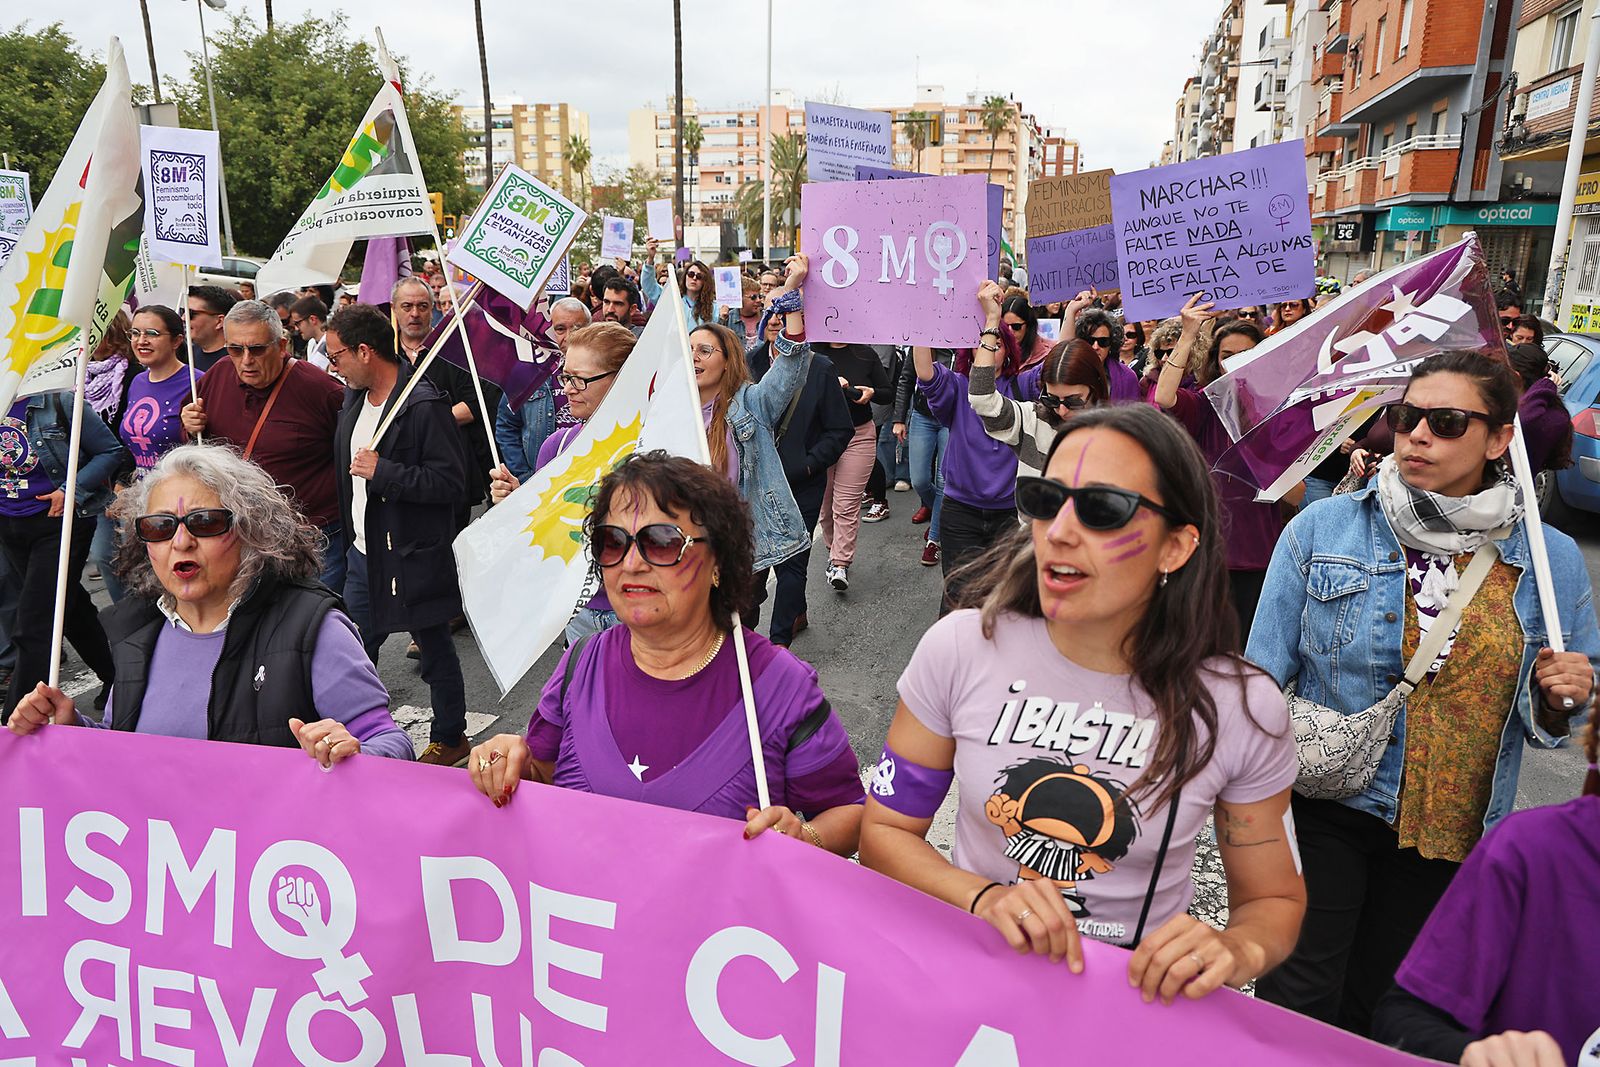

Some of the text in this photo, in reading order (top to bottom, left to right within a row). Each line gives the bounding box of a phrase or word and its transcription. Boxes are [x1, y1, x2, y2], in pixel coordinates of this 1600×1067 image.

[811, 115, 820, 124] LA
[820, 116, 850, 130] MAESTRA
[161, 166, 187, 184] 8M
[1033, 173, 1111, 201] FEMINISMO
[157, 193, 203, 203] para cambiarlo
[1140, 167, 1269, 211] MARCHAR!!!
[187, 202, 203, 210] todo
[507, 194, 551, 225] 8M
[1123, 200, 1250, 236] AUNQUE NO TE
[1478, 206, 1533, 223] optical
[489, 212, 553, 247] ANDALUZAS
[1397, 216, 1425, 225] optical
[484, 218, 548, 254] LEVANTAOS
[1125, 231, 1178, 255] FALTE
[1337, 229, 1353, 239] 5€
[821, 225, 918, 289] 8 M
[1030, 239, 1056, 255] ANTI
[1071, 250, 1081, 263] Y
[1127, 235, 1313, 279] PORQUE A ALGUNAS
[1029, 270, 1062, 293] ANTI
[1131, 258, 1288, 298] LES FALTA DE
[420, 855, 617, 1032] DE
